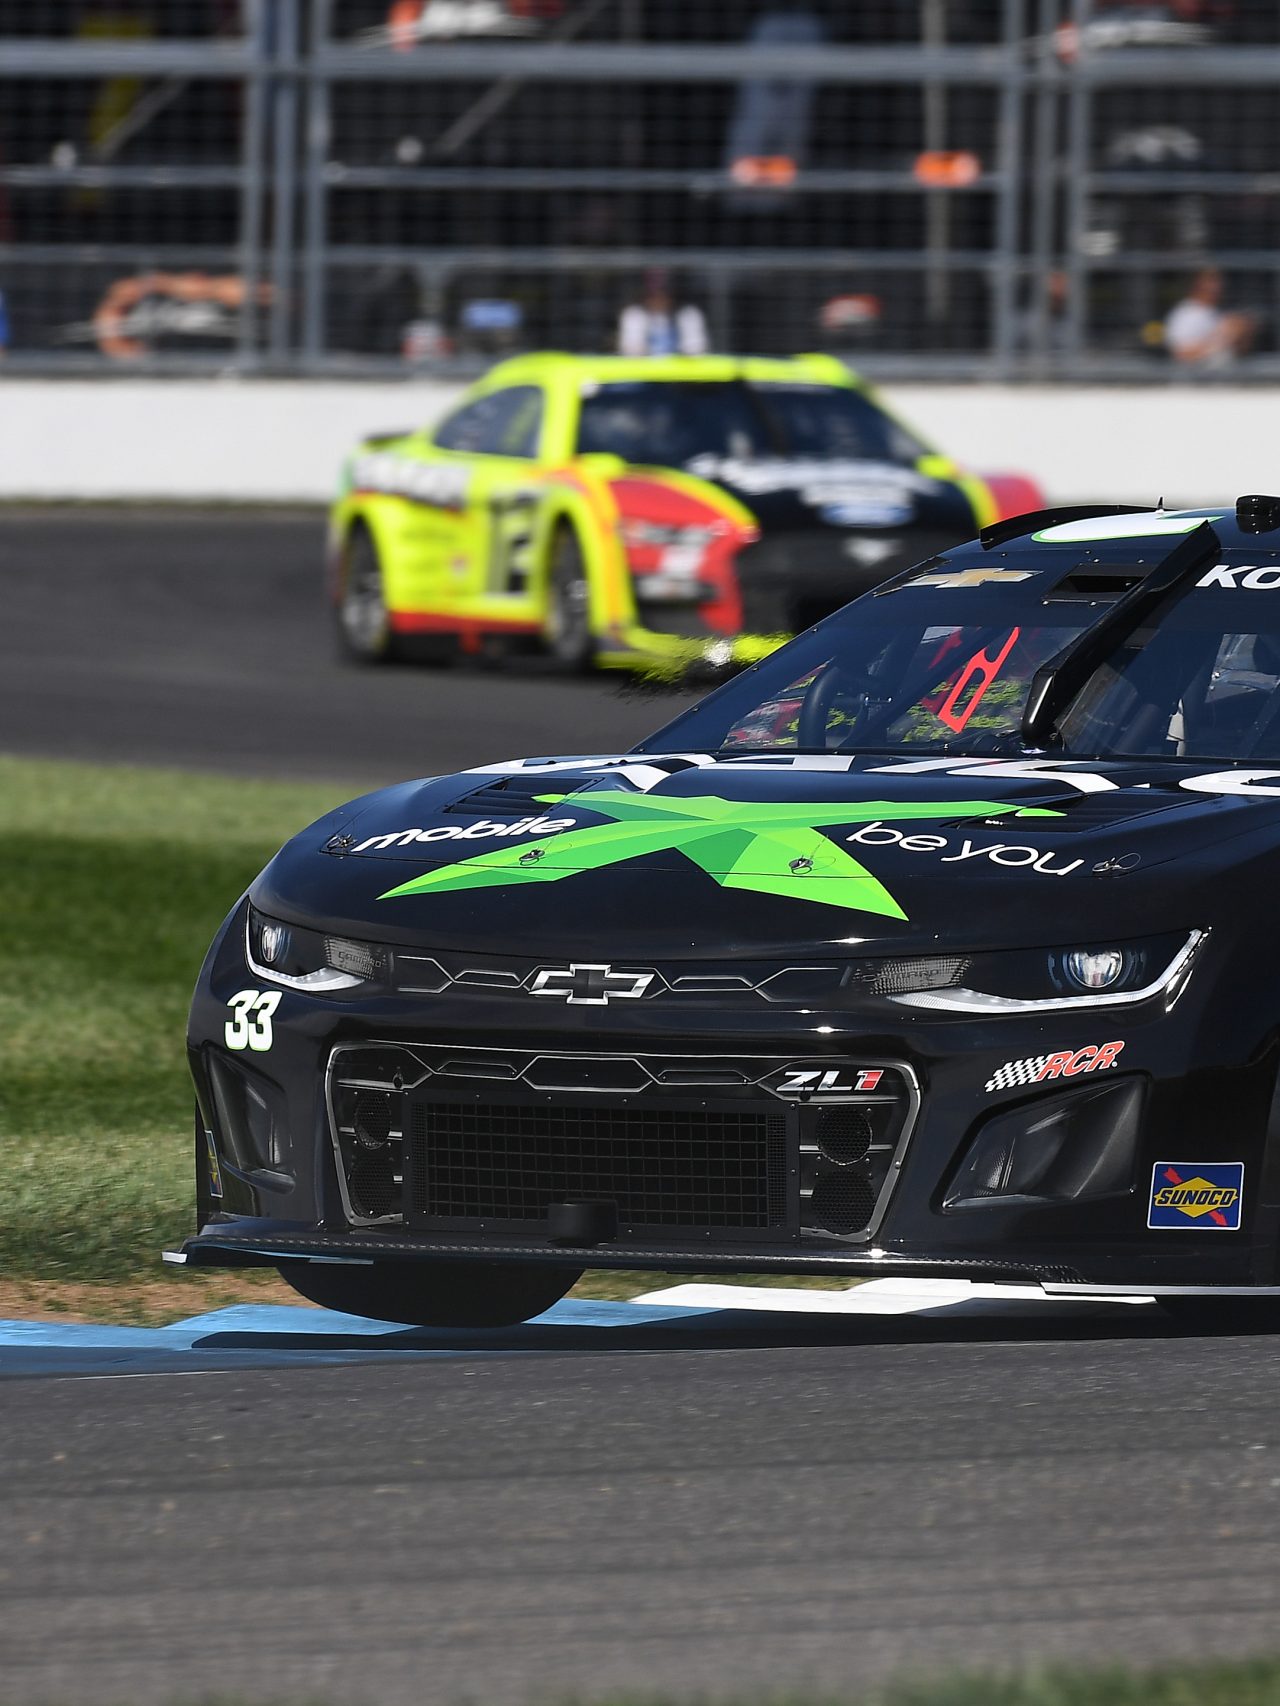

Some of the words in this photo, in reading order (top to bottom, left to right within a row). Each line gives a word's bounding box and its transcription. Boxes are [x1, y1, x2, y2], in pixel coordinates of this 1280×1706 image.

[350, 816, 567, 852] mobile
[846, 821, 948, 851] be
[940, 839, 1085, 876] you
[224, 989, 283, 1052] 33
[776, 1069, 884, 1092] ZL1
[1033, 1040, 1126, 1082] RCR
[1155, 1188, 1237, 1207] SUNOCO
